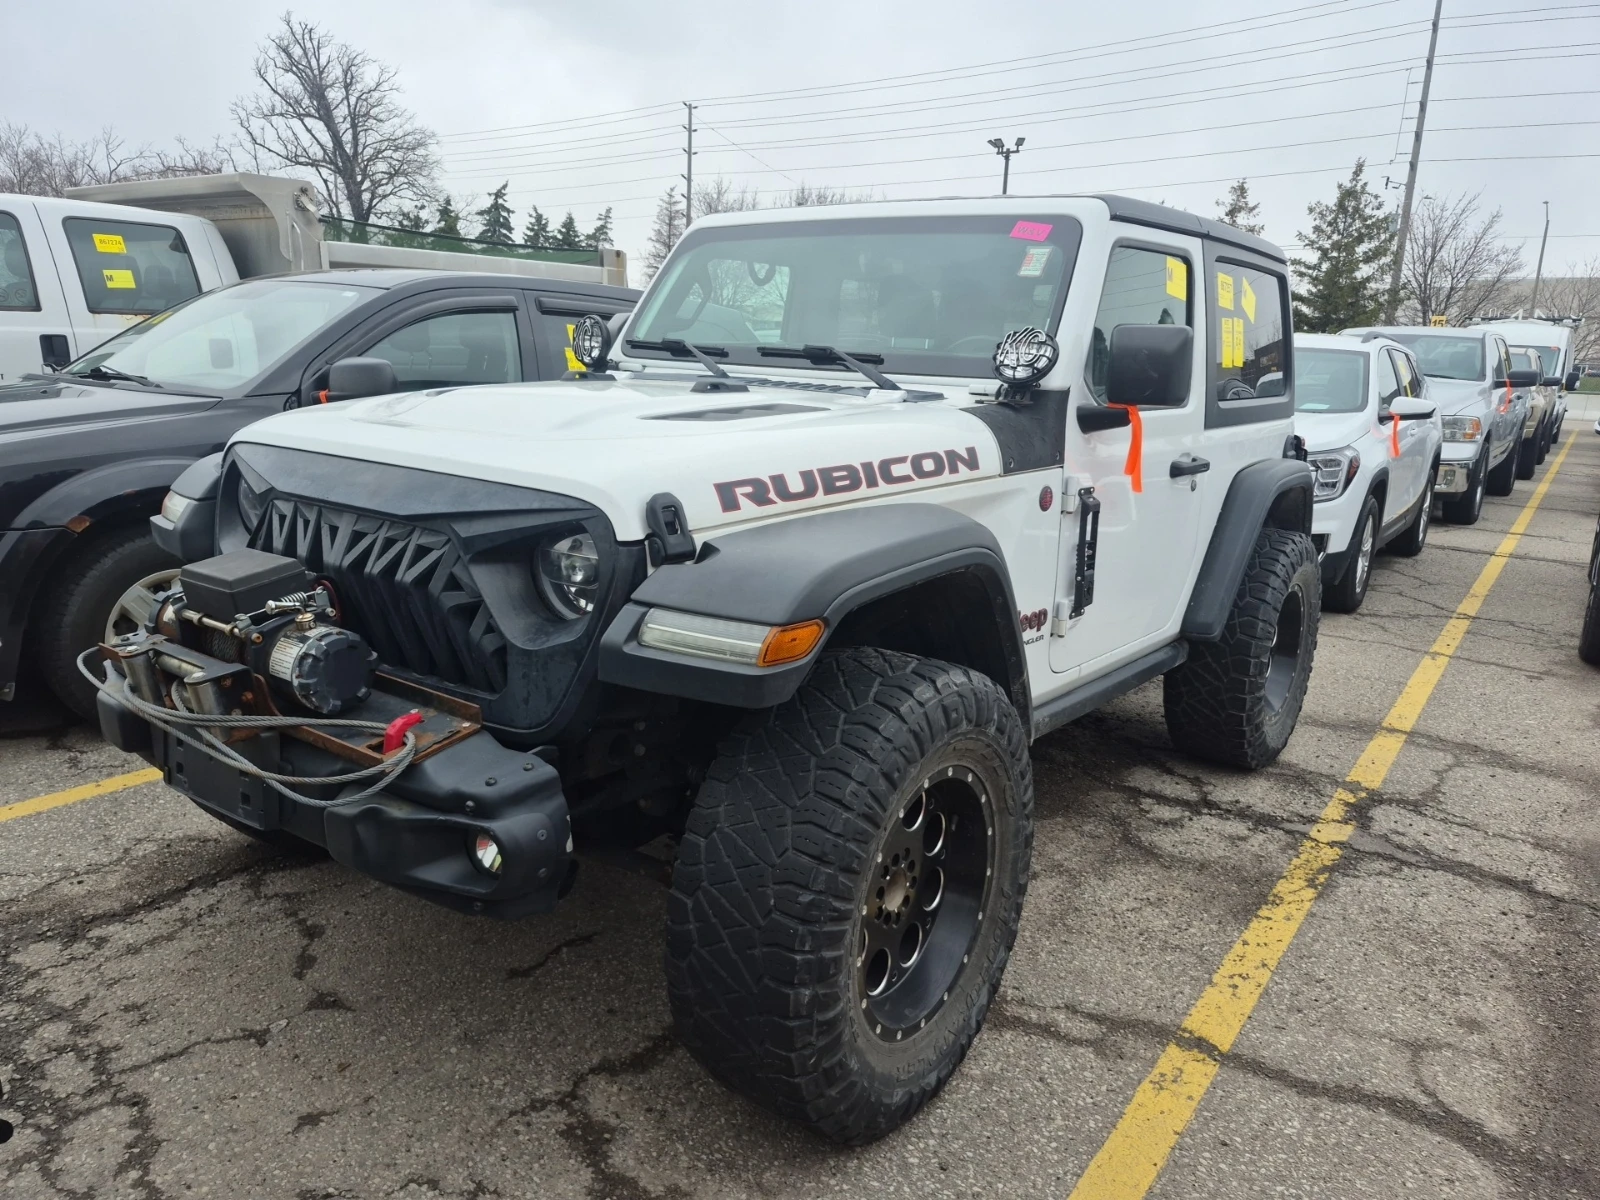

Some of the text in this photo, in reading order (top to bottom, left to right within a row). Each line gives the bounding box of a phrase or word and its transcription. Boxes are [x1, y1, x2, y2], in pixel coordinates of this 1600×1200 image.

[105, 274, 114, 282] M
[998, 326, 1047, 368] KC
[713, 446, 981, 514] RUBICON
[1018, 608, 1048, 633] eep
